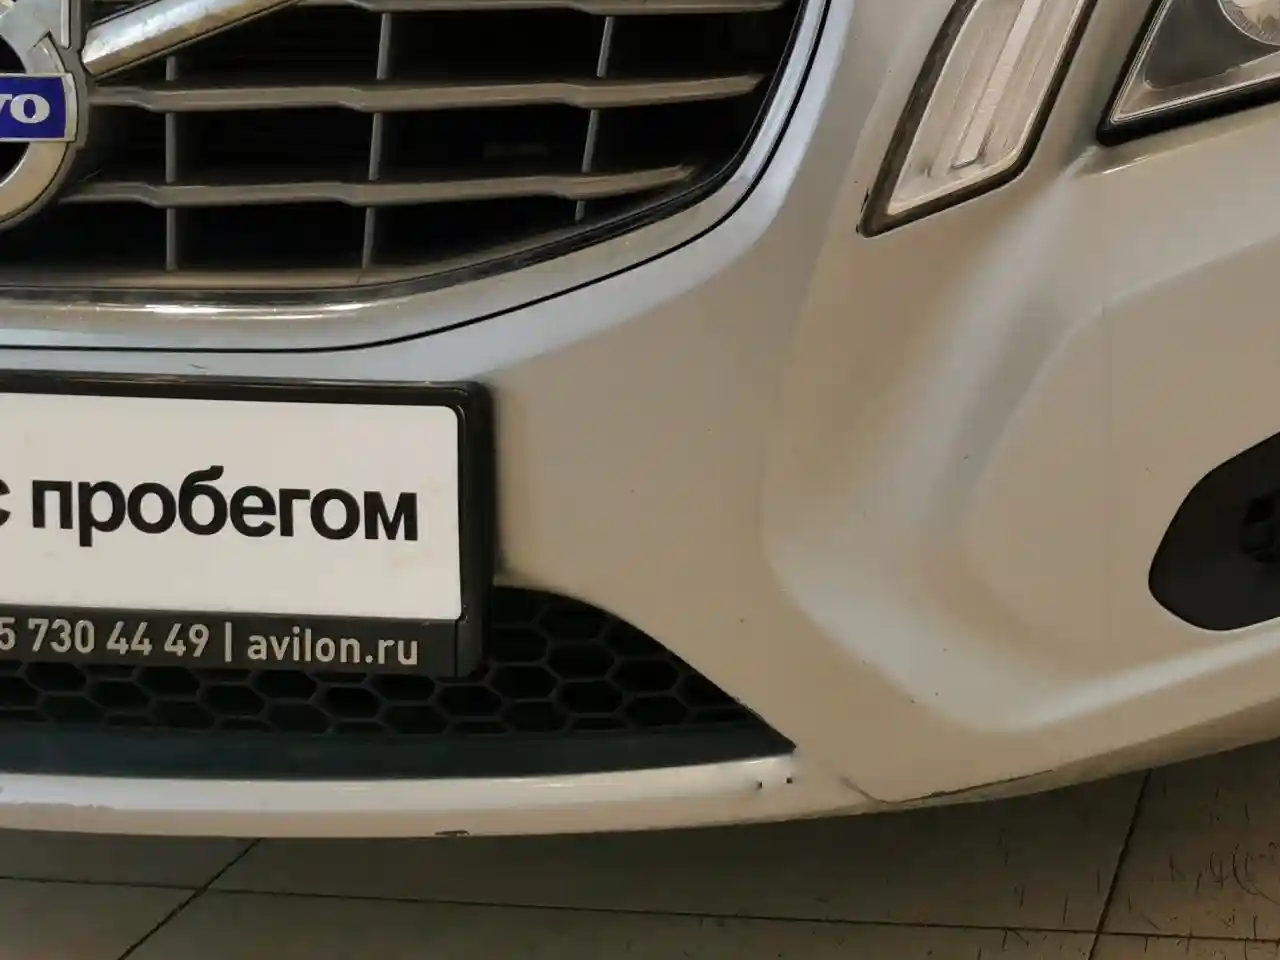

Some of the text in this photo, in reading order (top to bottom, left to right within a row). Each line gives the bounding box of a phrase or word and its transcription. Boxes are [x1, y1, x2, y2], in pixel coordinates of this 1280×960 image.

[32, 465, 418, 547] пробегом
[28, 617, 96, 654] 730
[106, 620, 153, 656] 44
[163, 623, 210, 657] 49
[247, 626, 418, 666] avilon.ru
